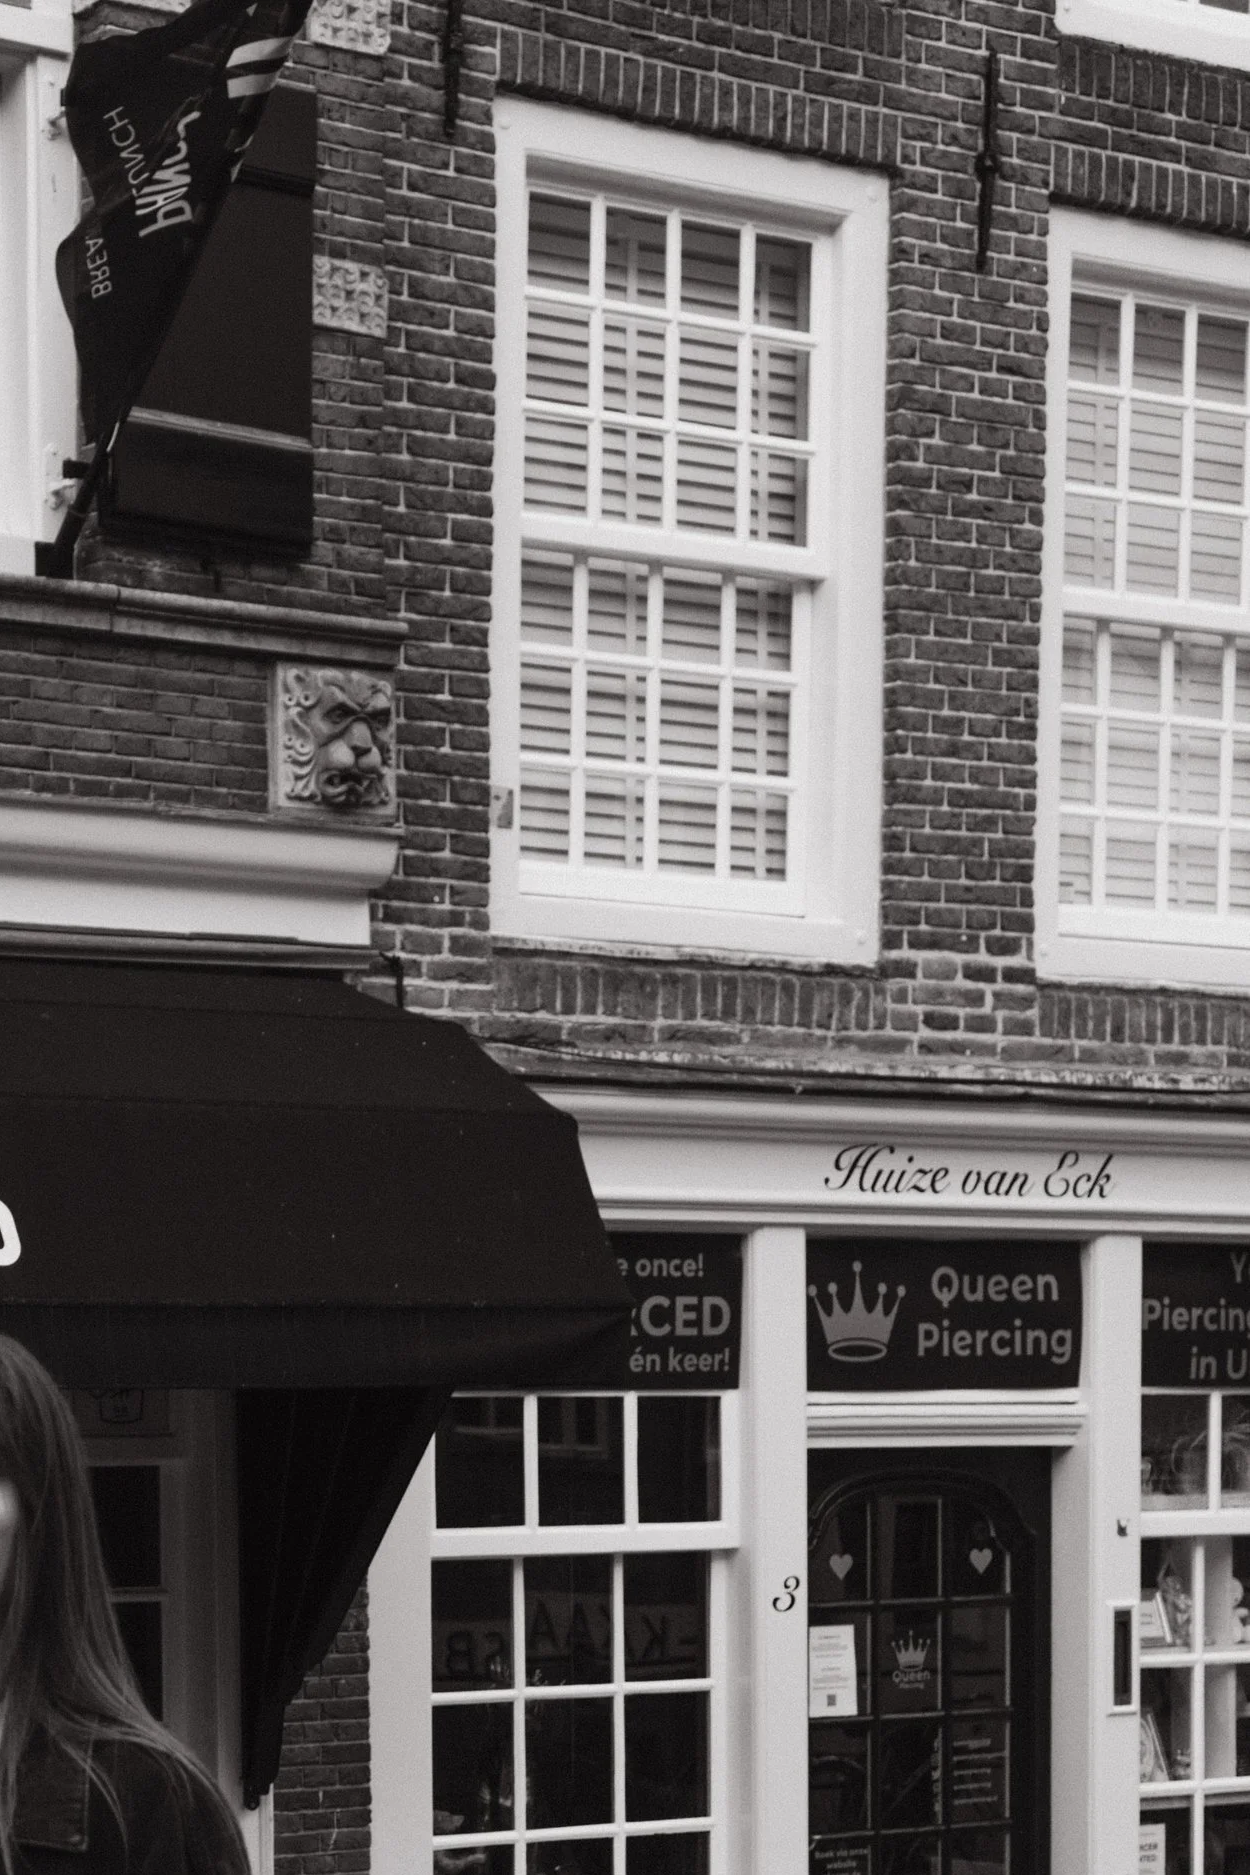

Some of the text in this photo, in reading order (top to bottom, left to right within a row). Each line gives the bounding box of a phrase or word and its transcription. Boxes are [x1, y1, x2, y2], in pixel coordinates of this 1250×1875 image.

[824, 1143, 1115, 1198] Huize van Eck
[634, 1252, 704, 1277] once!
[1230, 1252, 1250, 1284] Y
[931, 1266, 1059, 1308] Queen
[1142, 1296, 1250, 1339] Piercin
[630, 1346, 730, 1372] én keer!
[916, 1318, 1073, 1365] Piercing
[1190, 1346, 1250, 1380] in U
[772, 1575, 801, 1613] 3
[892, 1670, 931, 1683] Queen
